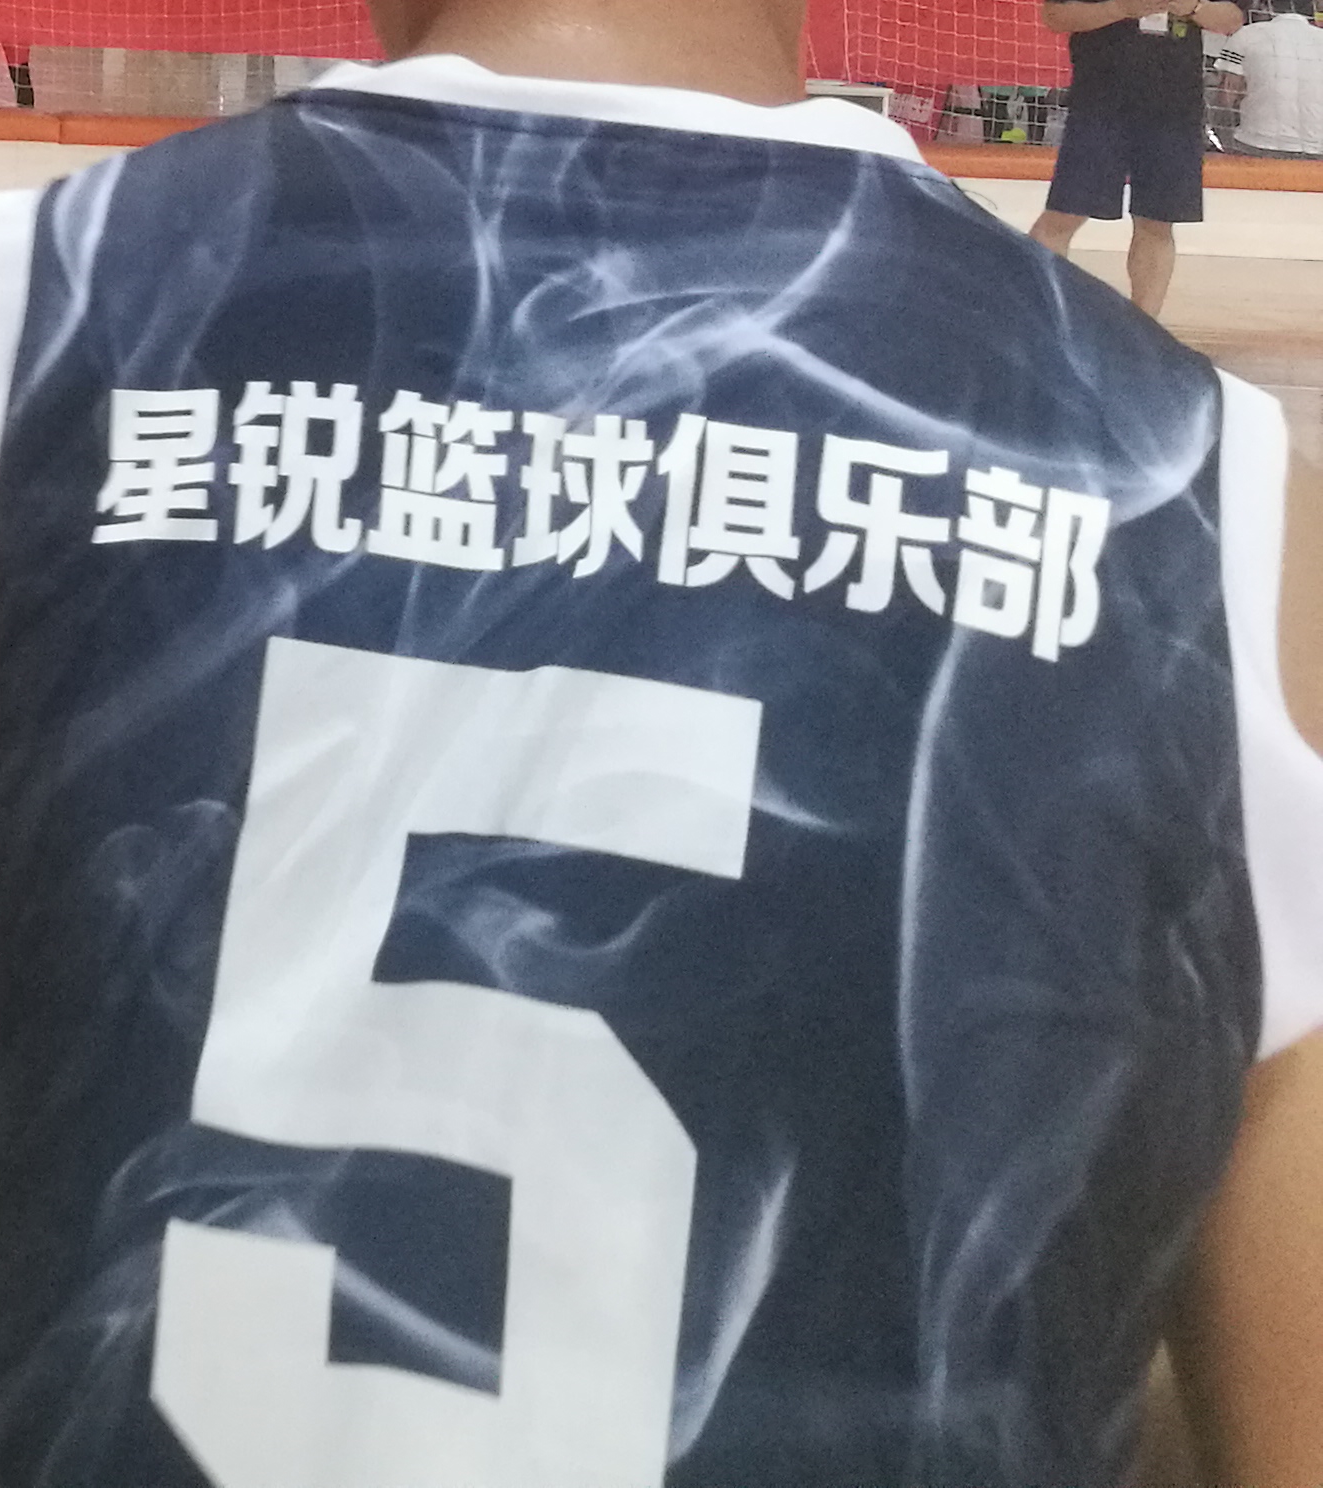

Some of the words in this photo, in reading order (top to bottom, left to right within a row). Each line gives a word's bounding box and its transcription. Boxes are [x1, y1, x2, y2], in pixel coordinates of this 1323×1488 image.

[91, 380, 1111, 662] 星锐篮球俱乐部
[150, 636, 762, 1488] 5
